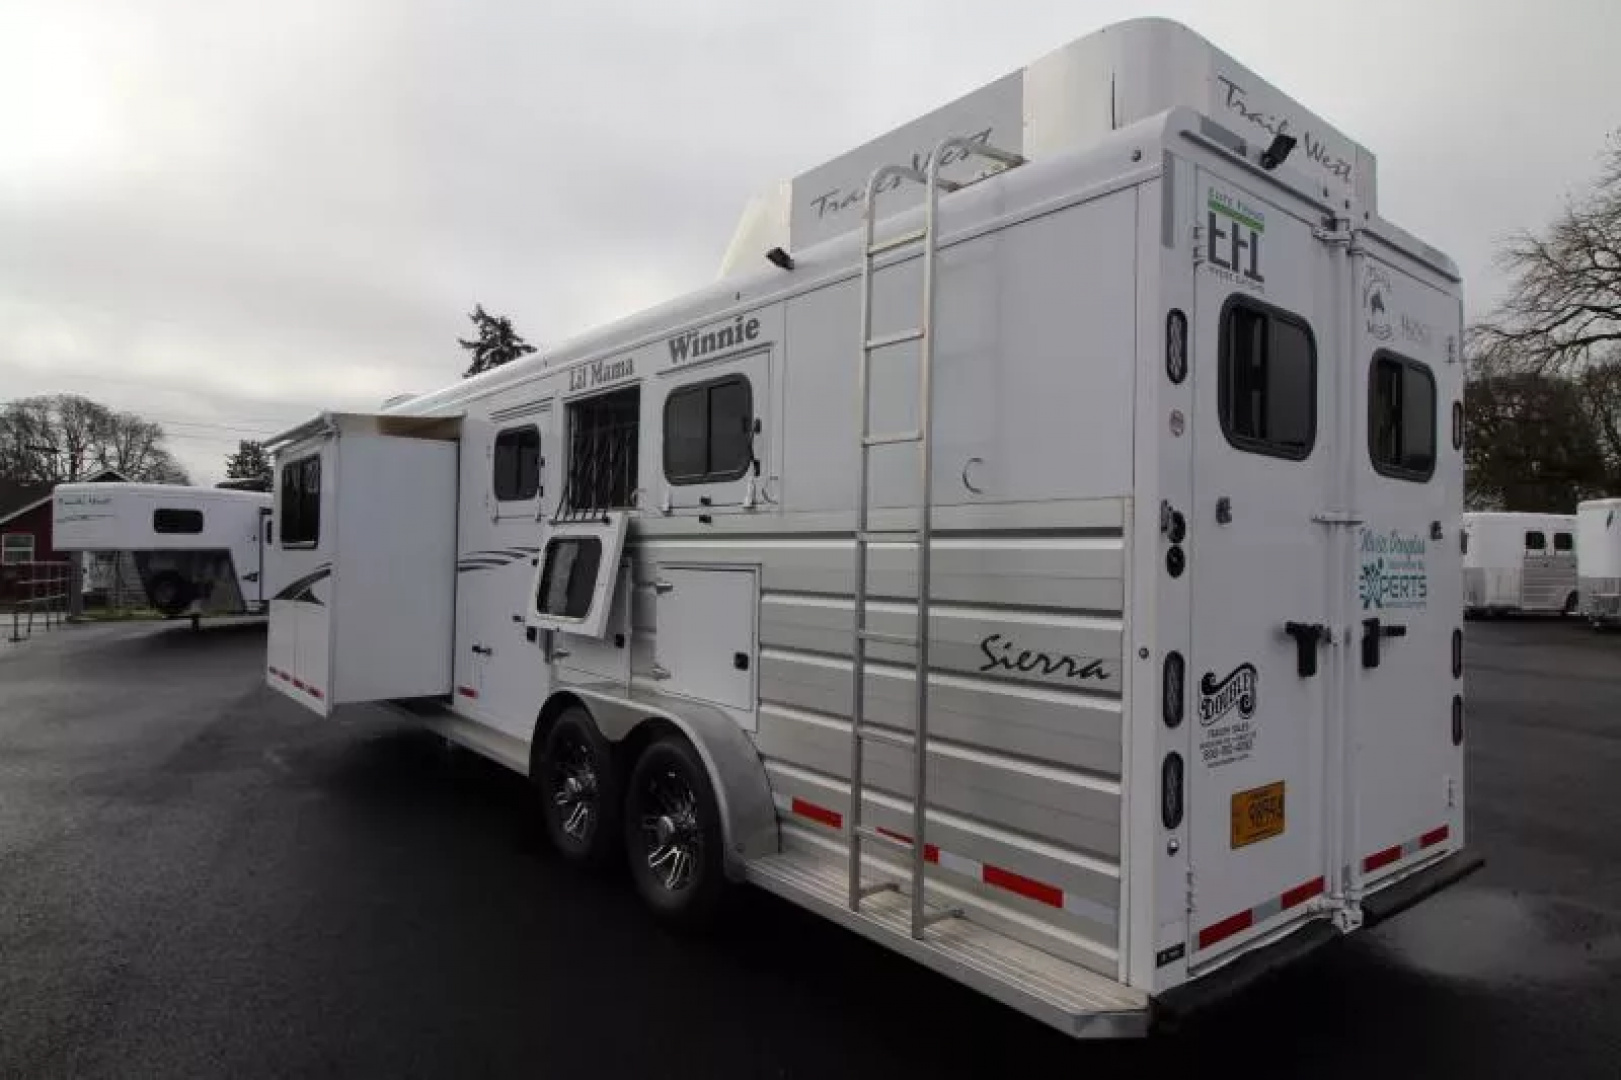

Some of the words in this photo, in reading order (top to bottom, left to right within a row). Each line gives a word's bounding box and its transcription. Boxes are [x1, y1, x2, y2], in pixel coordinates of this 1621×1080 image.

[1217, 74, 1289, 140] Trail
[668, 315, 760, 364] Winnie
[590, 357, 634, 385] Mama
[979, 634, 1111, 680] Sierra
